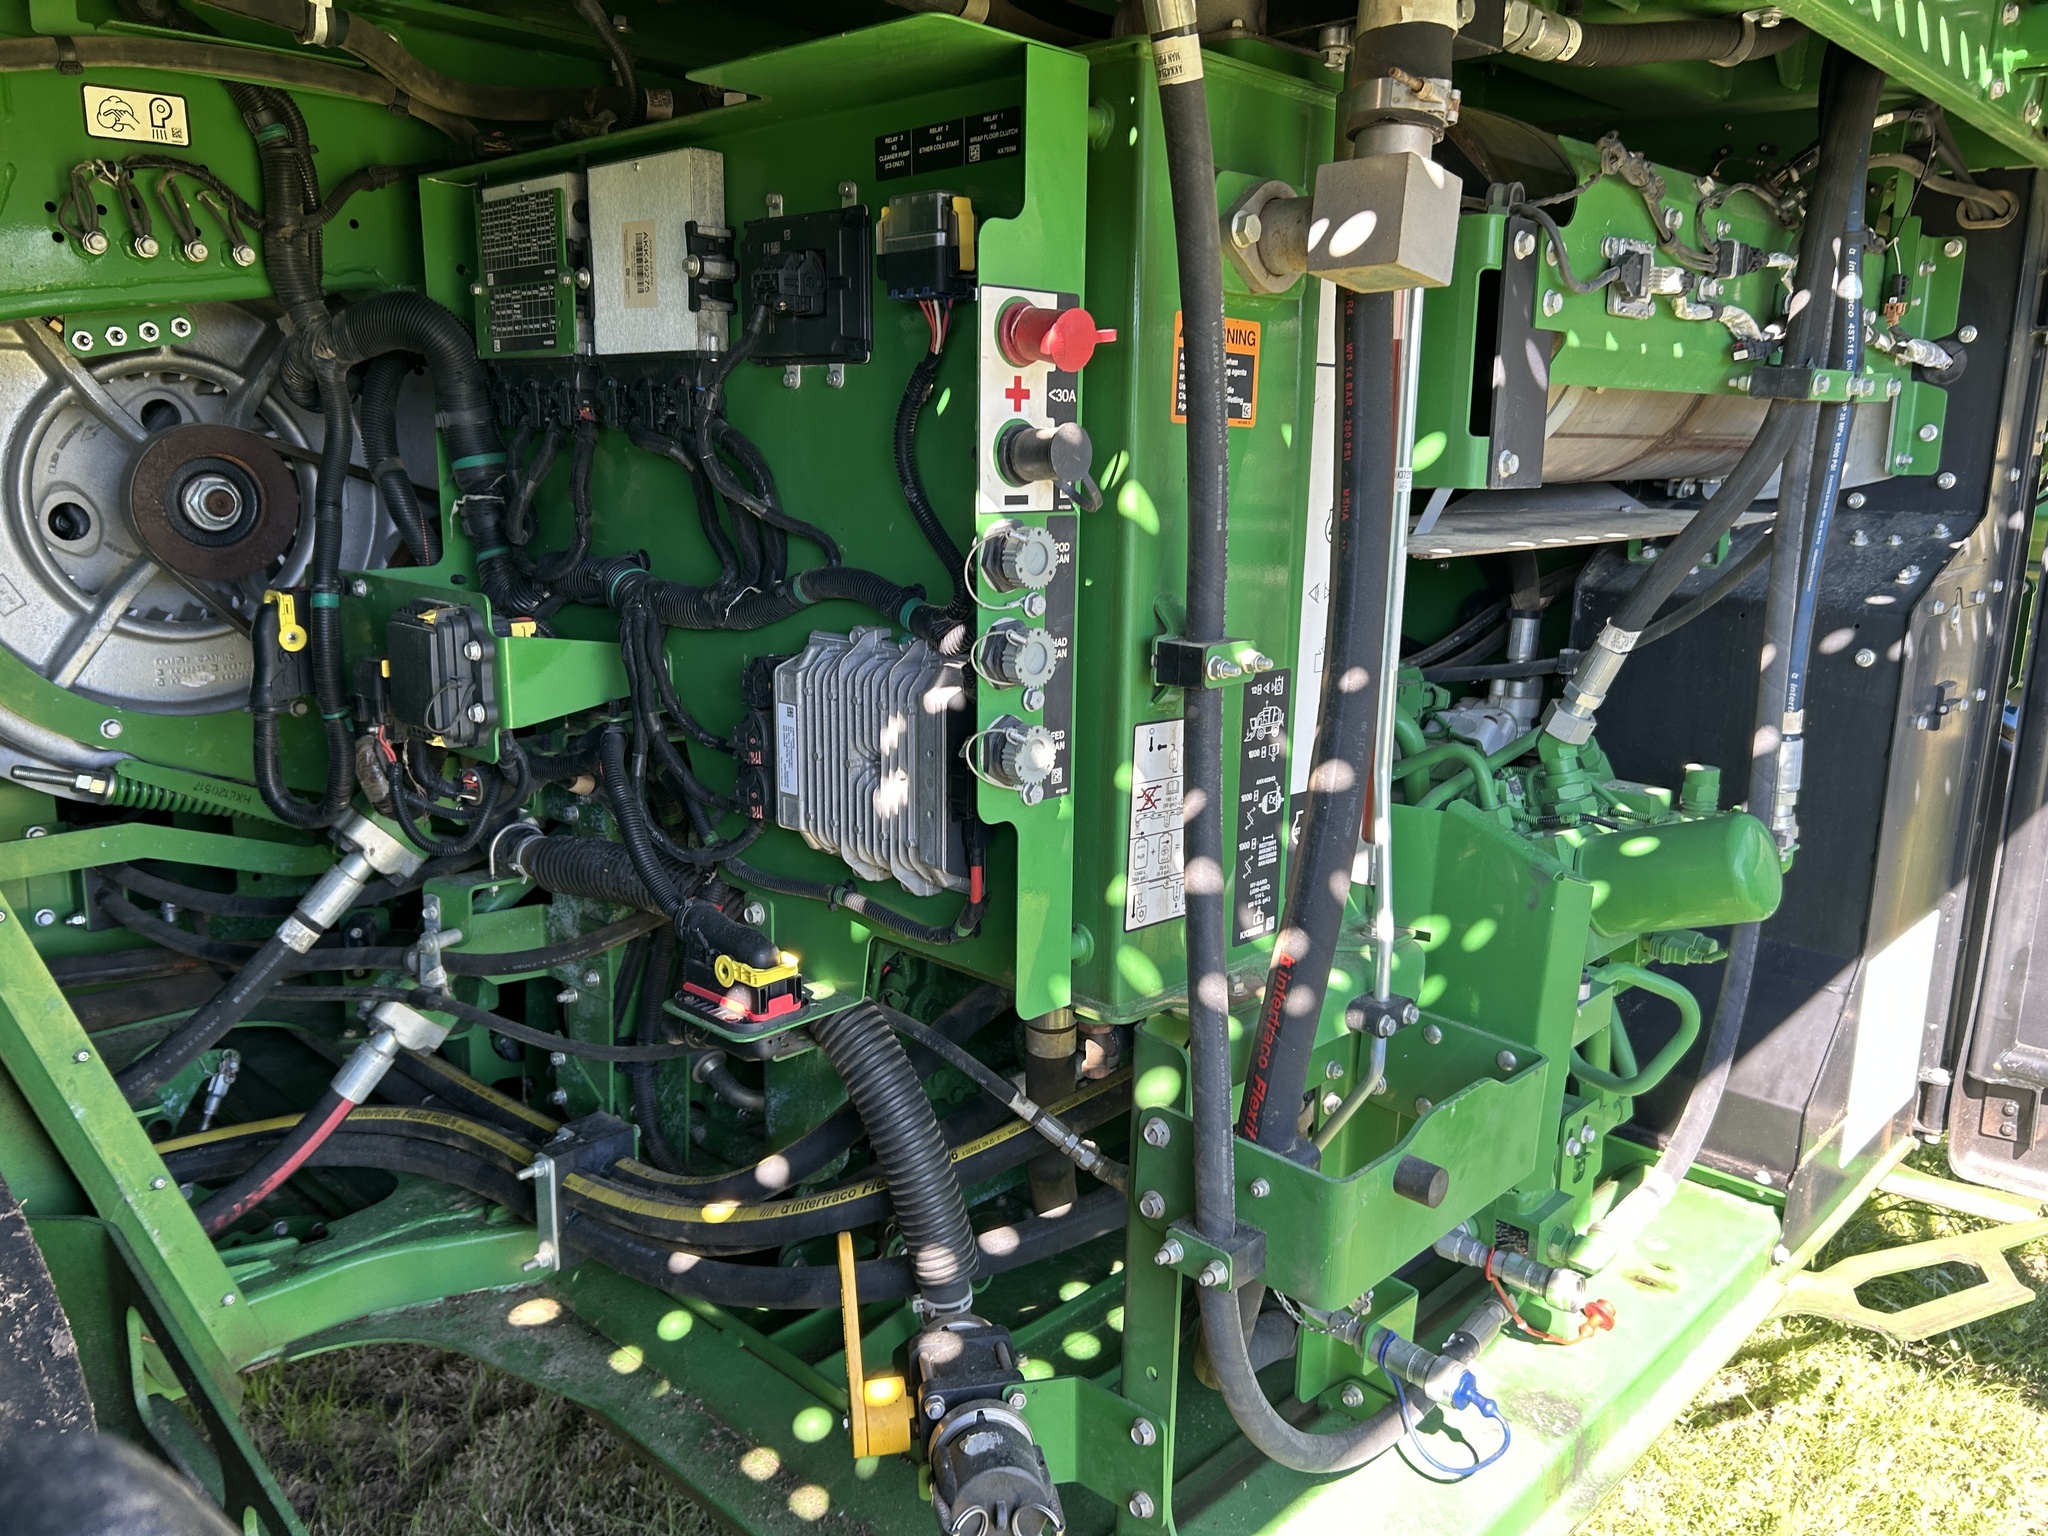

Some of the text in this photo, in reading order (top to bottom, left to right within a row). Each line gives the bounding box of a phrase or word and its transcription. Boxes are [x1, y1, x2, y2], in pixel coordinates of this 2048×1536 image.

[982, 114, 998, 123] RELAY
[929, 126, 944, 134] RELAY
[970, 128, 1019, 144] WRAP FLOOR CLUTCH
[884, 136, 898, 144] RELAY
[919, 140, 960, 154] ETHER COLD START
[878, 150, 910, 162] CLEANER PUMP
[1226, 328, 1256, 347] NING
[1344, 342, 1353, 361] WP
[1344, 365, 1352, 378] 14
[1846, 360, 1854, 371] DN
[1048, 389, 1076, 403] <30A
[1344, 382, 1353, 407] BAR
[1344, 418, 1352, 438] 200
[1836, 422, 1846, 438] MPa
[1343, 441, 1352, 461] PSI
[1832, 442, 1842, 459] 5000
[1830, 460, 1838, 471] PSI
[1340, 488, 1350, 520] MSHA
[1251, 686, 1258, 695] 12
[1248, 749, 1260, 758] 1000
[1240, 792, 1252, 802] 1000
[1238, 840, 1250, 852] 1000
[1244, 970, 1292, 1140] intertraco Flexit
[982, 1140, 988, 1149] DN
[792, 1188, 856, 1212] intertraco
